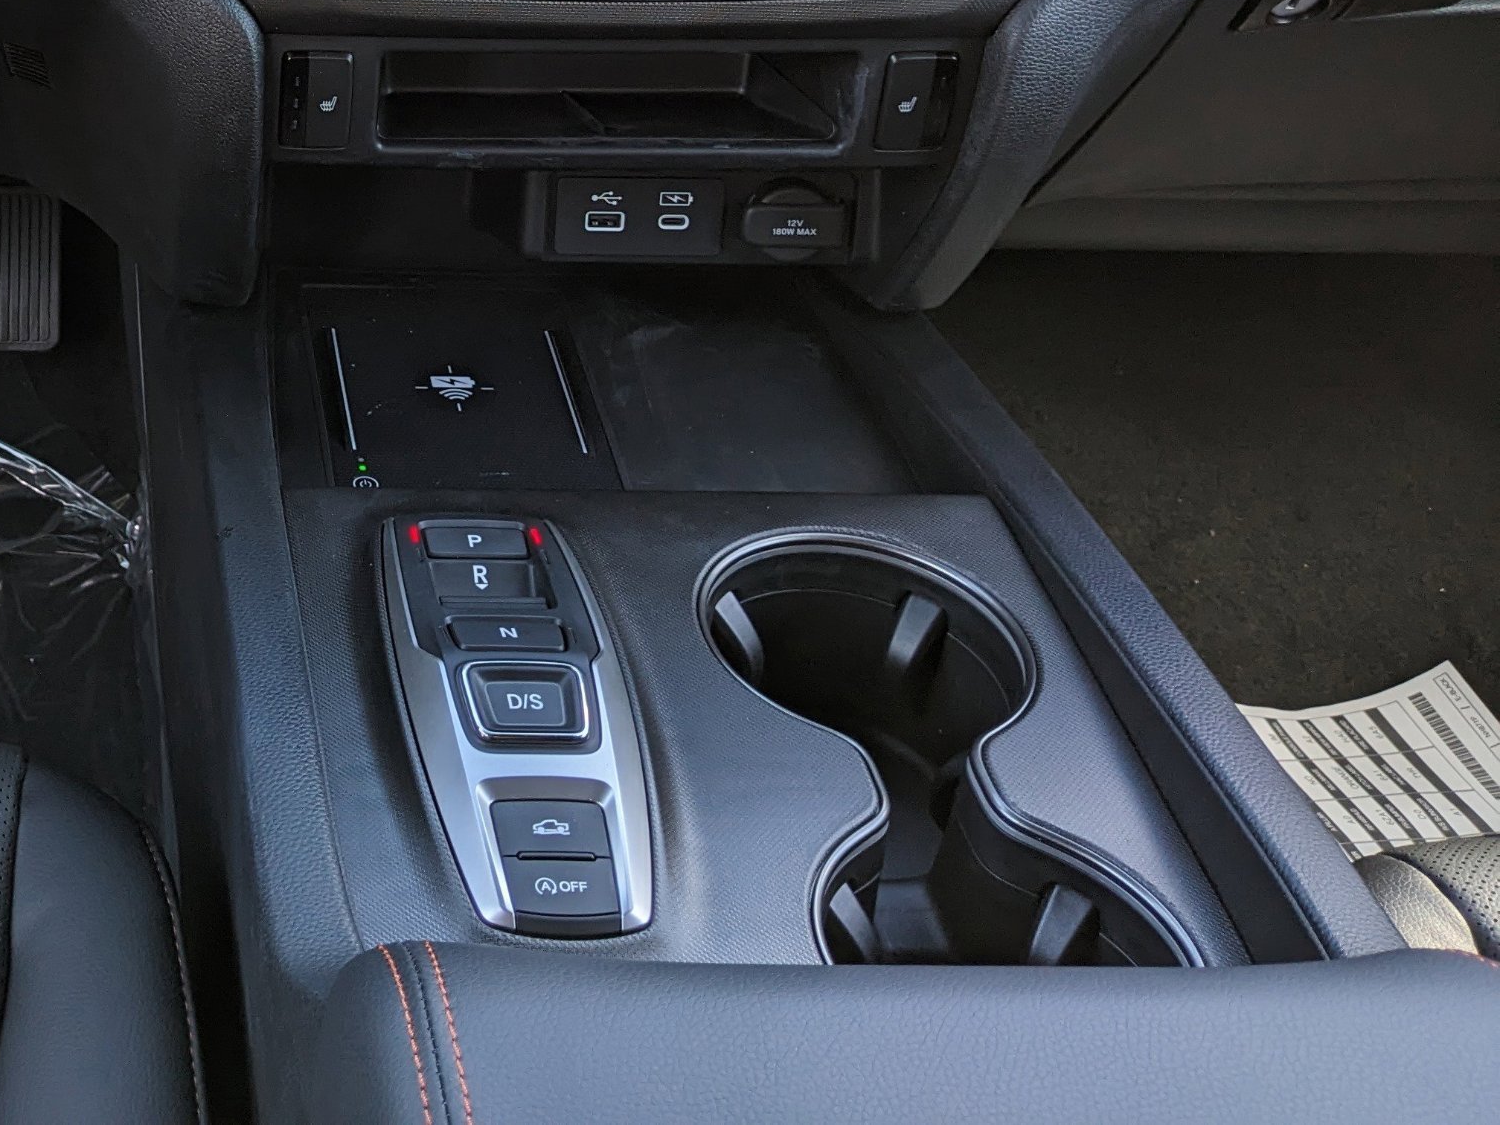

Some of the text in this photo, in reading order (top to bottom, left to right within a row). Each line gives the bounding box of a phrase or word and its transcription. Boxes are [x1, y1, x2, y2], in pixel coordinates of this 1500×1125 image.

[787, 219, 803, 227] 12V
[772, 228, 817, 236] 180W MAX
[467, 534, 482, 548] P
[472, 564, 488, 584] R
[499, 626, 518, 638] N
[506, 693, 544, 710] D/S
[559, 881, 588, 893] OFF
